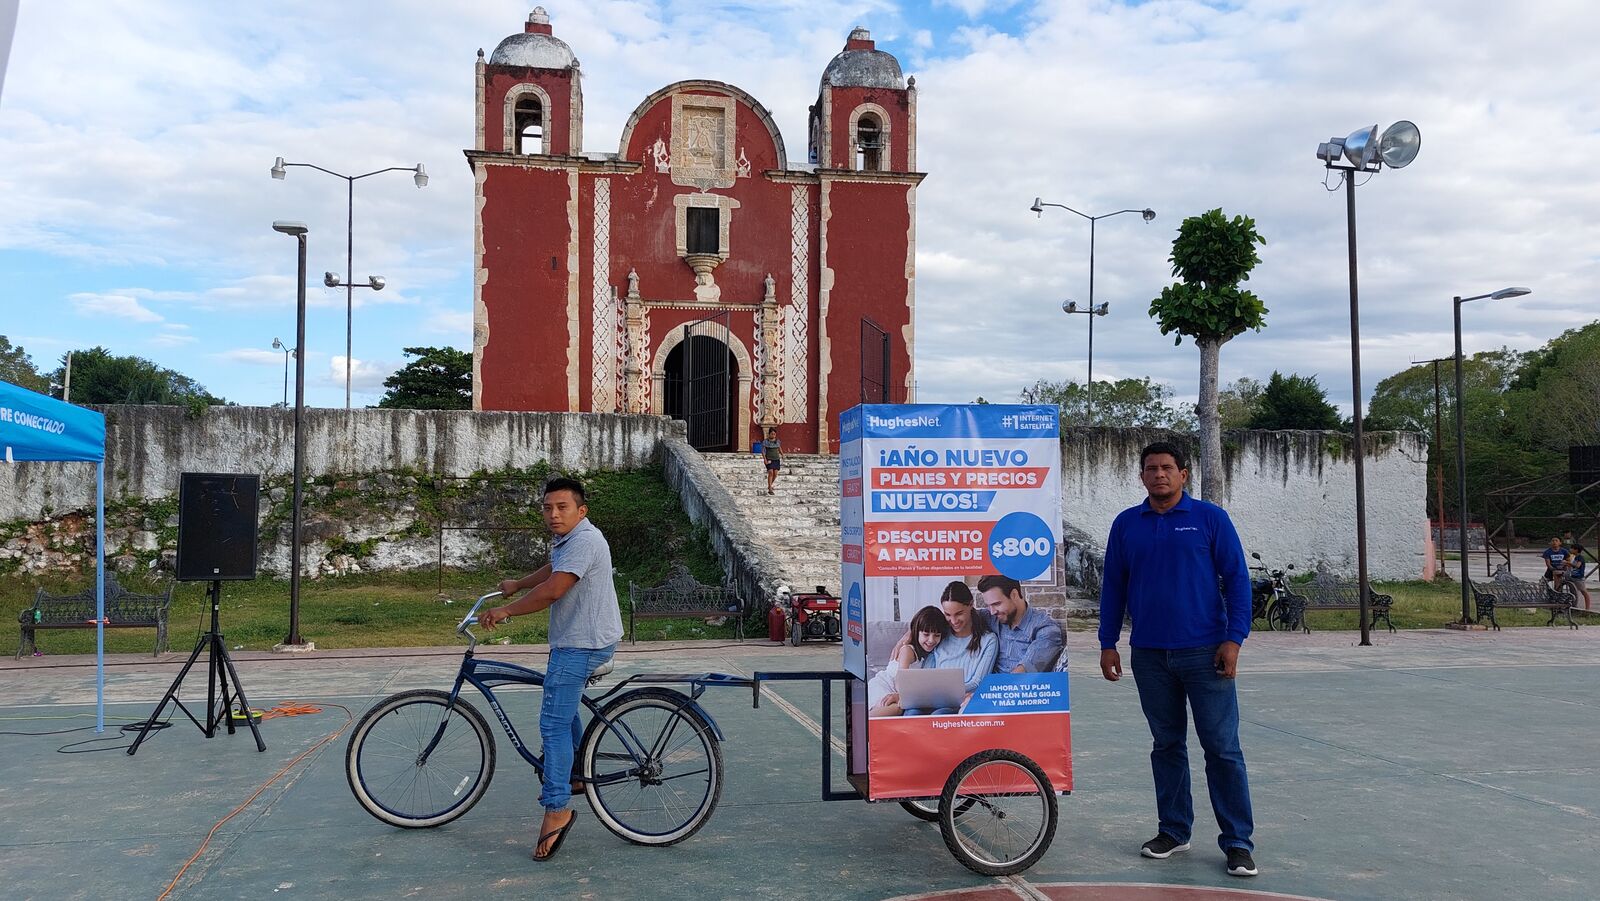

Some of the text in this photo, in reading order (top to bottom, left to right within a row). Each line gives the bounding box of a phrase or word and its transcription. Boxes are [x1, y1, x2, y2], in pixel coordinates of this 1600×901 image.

[14, 410, 66, 435] CONECTADO
[1001, 414, 1019, 430] #1
[1020, 414, 1053, 422] INTERNET
[880, 445, 939, 467] ¡AÑO
[945, 449, 1029, 467] NUEVO
[879, 472, 1038, 486] PLANES Y PRECIOS
[880, 493, 978, 510] NUEVOS!
[877, 530, 983, 544] DESCUENTO
[877, 547, 983, 561] A PARTIR DE
[992, 537, 1051, 559] $800
[999, 699, 1016, 707] MÁS
[490, 701, 521, 748] BENOTTO
[932, 720, 1005, 730] HughesNet.com.mx
